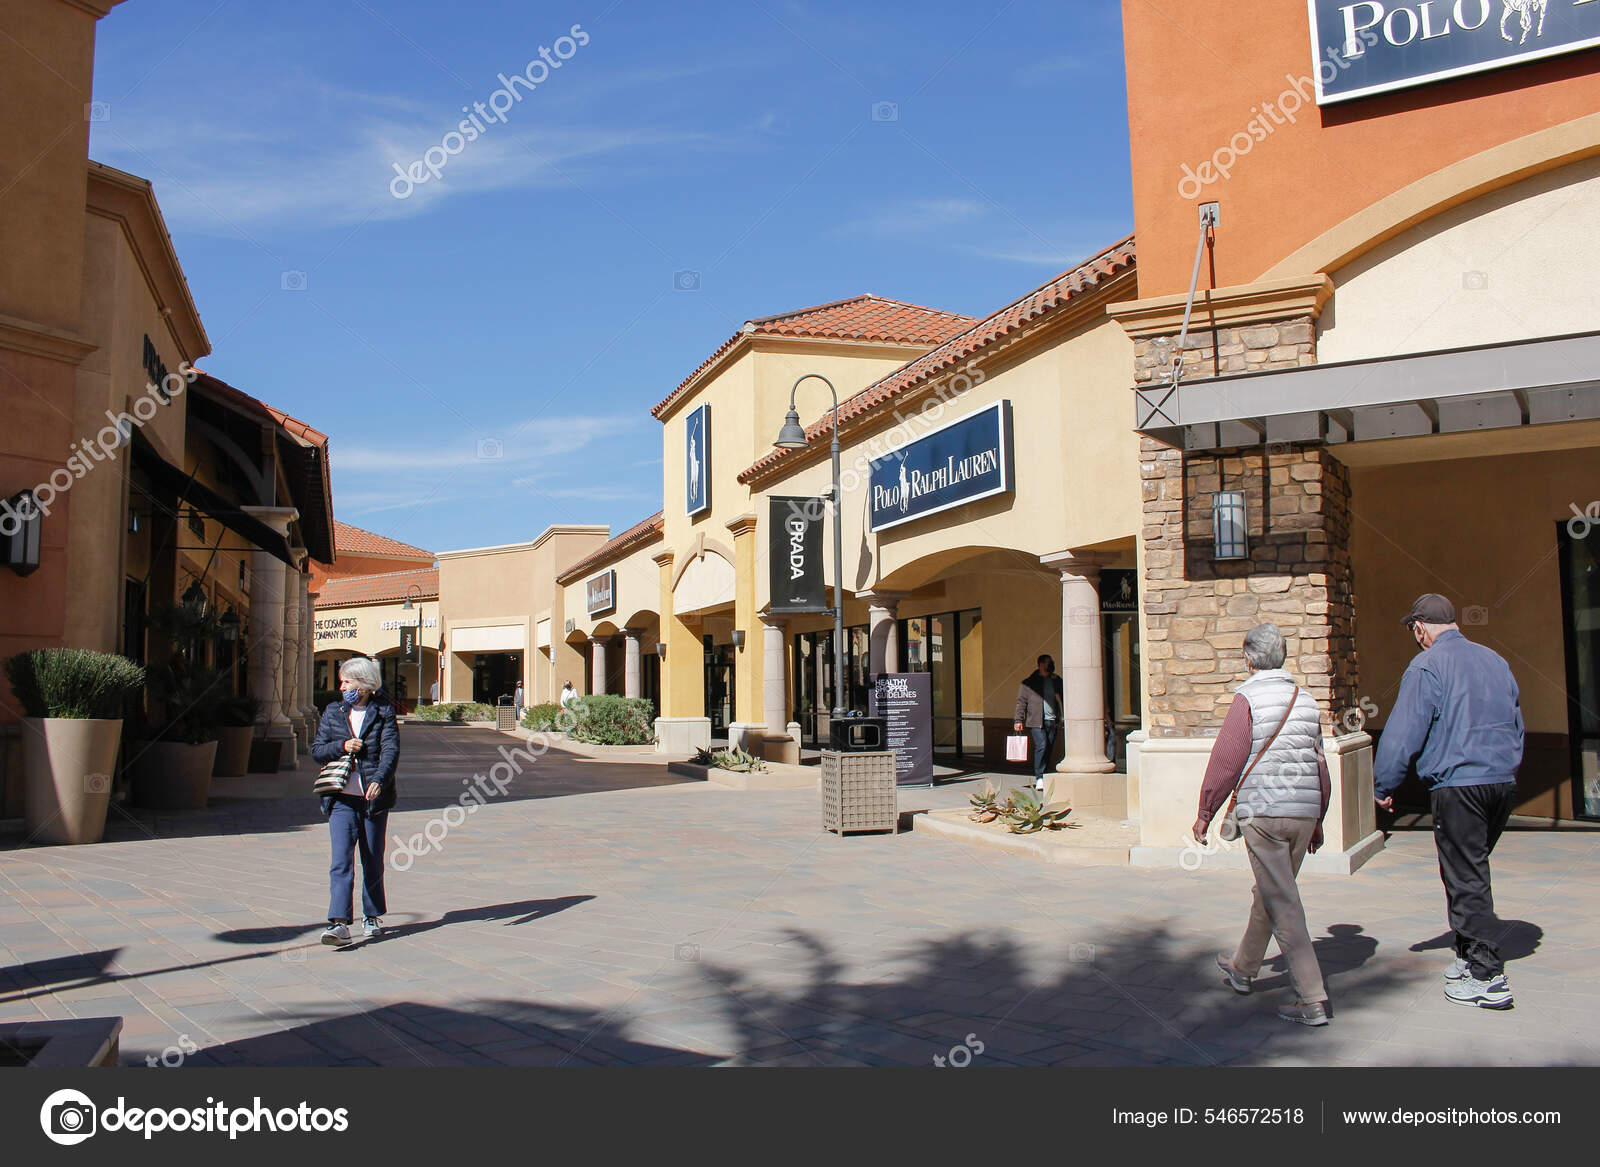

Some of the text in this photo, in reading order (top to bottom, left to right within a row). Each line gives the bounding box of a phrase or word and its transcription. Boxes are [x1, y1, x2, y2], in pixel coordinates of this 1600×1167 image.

[1338, 0, 1491, 58] POLO
[873, 447, 998, 513] POLO RALPH LAUREN
[790, 521, 805, 581] PRADA
[324, 617, 358, 629] COSMETICS
[340, 629, 358, 639] STORE
[875, 691, 917, 699] GUIDELINES
